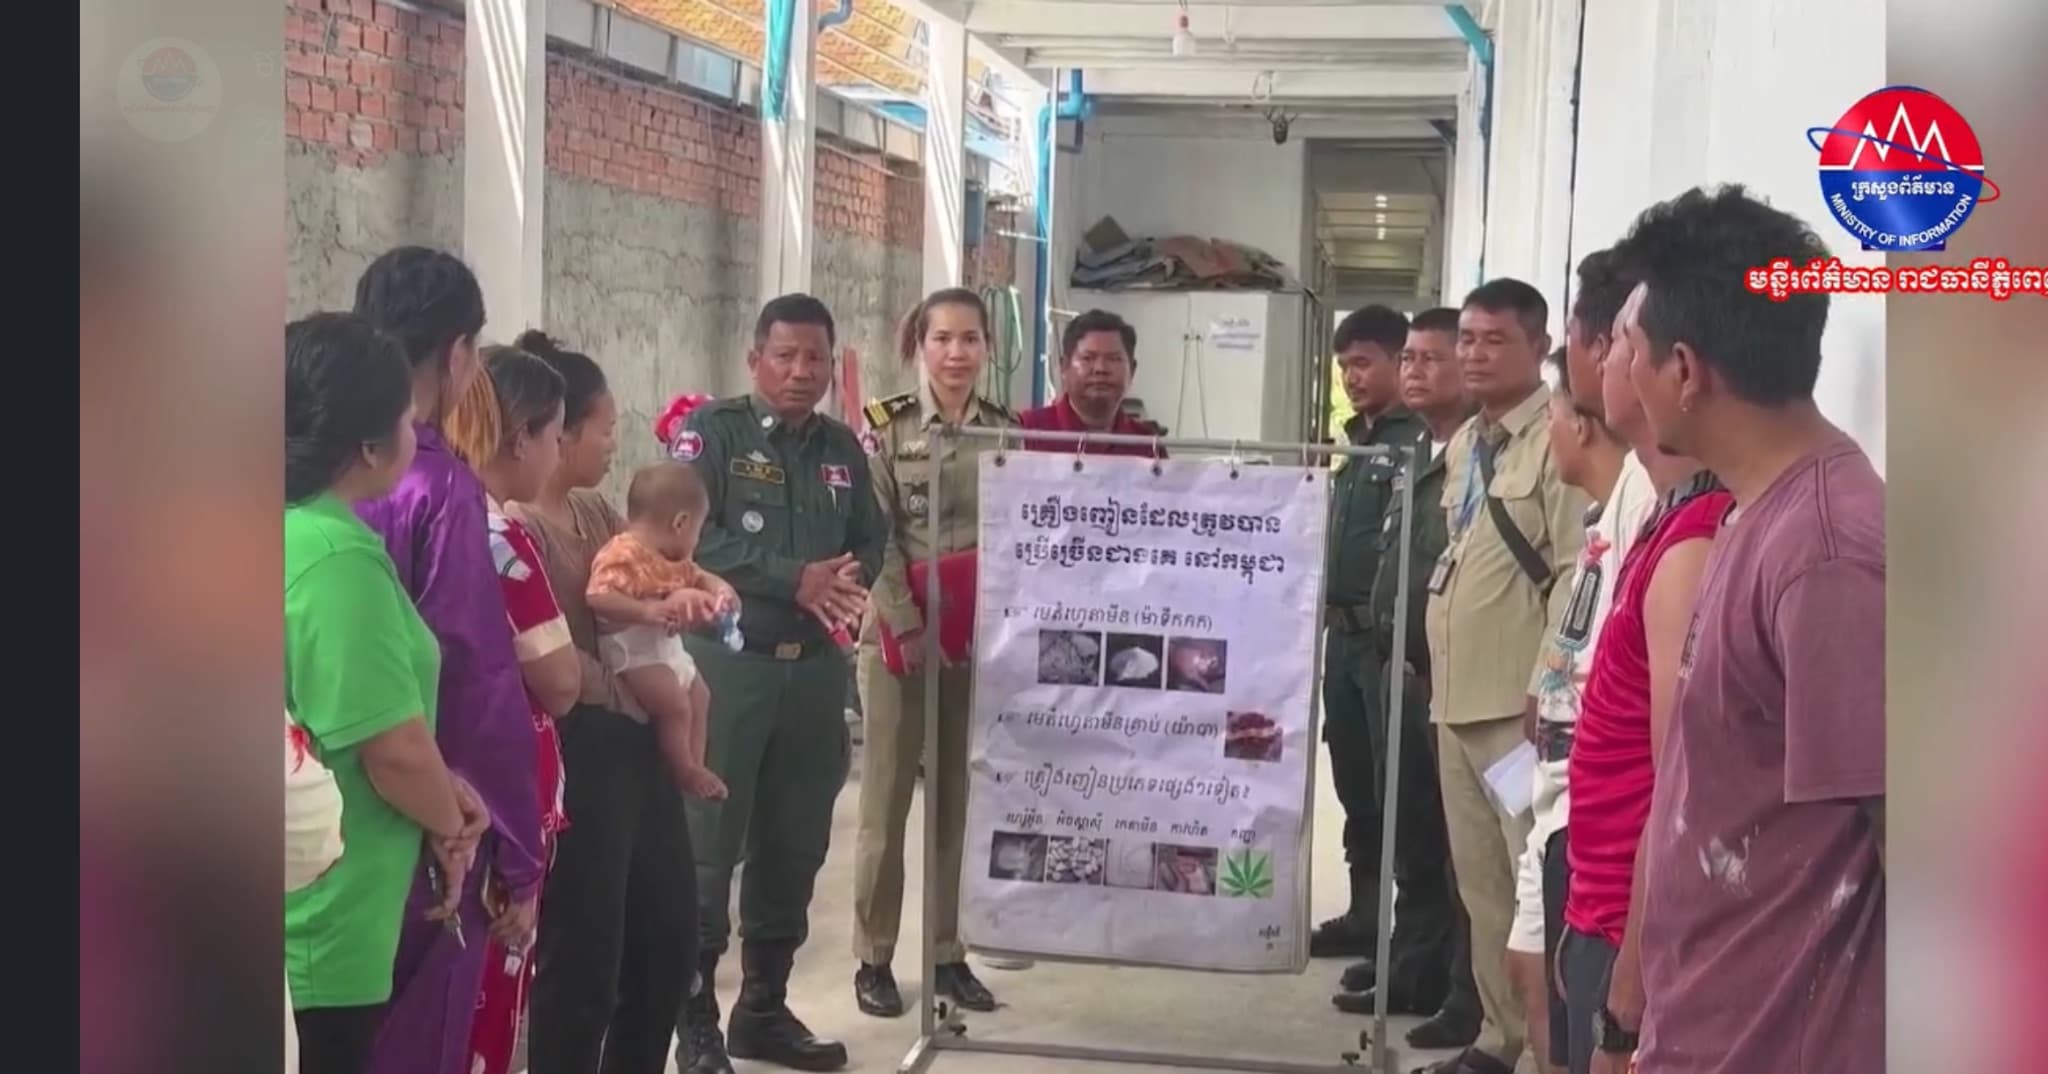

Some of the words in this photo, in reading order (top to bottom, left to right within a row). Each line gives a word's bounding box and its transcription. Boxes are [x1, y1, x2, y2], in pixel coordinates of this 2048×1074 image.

[1021, 495, 1282, 537] គ្រឿងញៀនដែលត្រូវបាន
[1185, 548, 1286, 585] នៅកម្ពុជា
